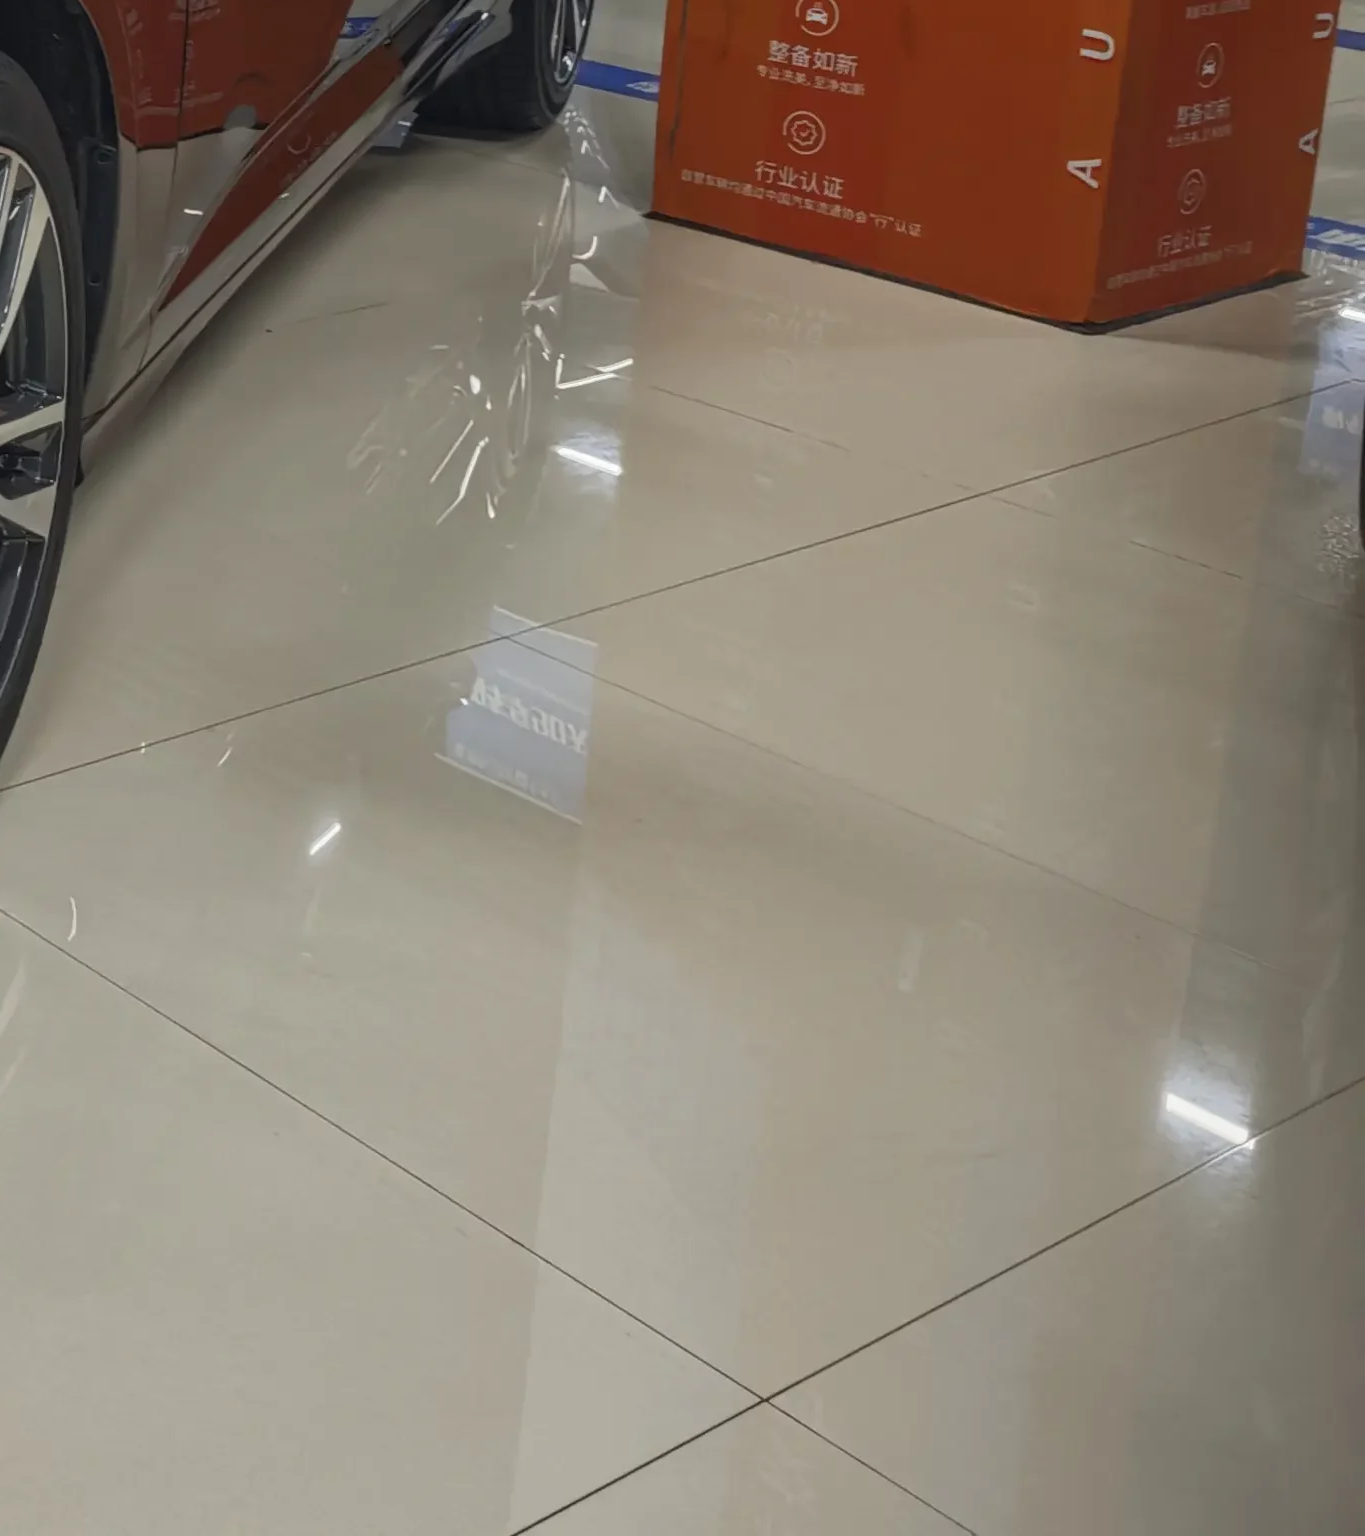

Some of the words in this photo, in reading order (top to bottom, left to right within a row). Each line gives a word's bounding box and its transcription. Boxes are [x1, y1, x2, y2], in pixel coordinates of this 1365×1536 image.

[767, 39, 858, 77] 整备如新
[754, 160, 845, 200] 行业认证
